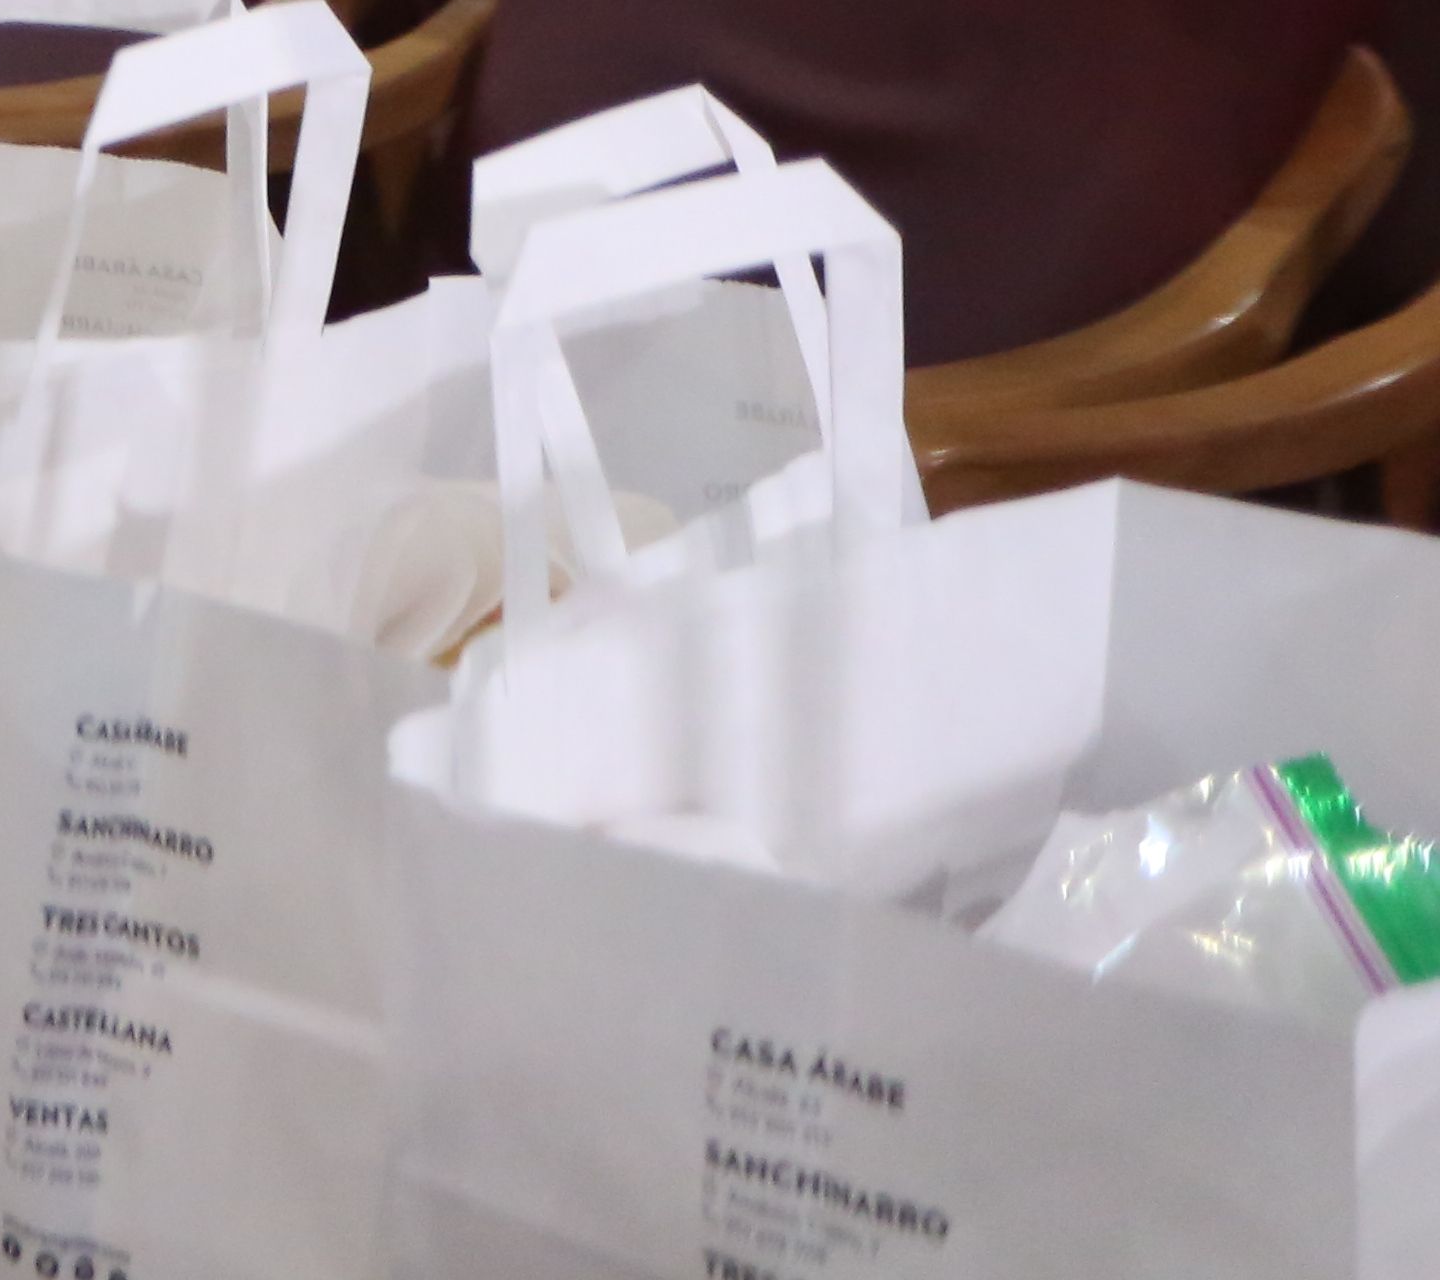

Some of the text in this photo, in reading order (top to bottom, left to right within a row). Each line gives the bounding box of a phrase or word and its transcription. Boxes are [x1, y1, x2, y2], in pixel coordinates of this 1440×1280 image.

[23, 1002, 173, 1056] CASTELLANA
[709, 1027, 797, 1078] CASA
[9, 1094, 110, 1138] VENTAS
[705, 1137, 951, 1244] SANCHINARRO
